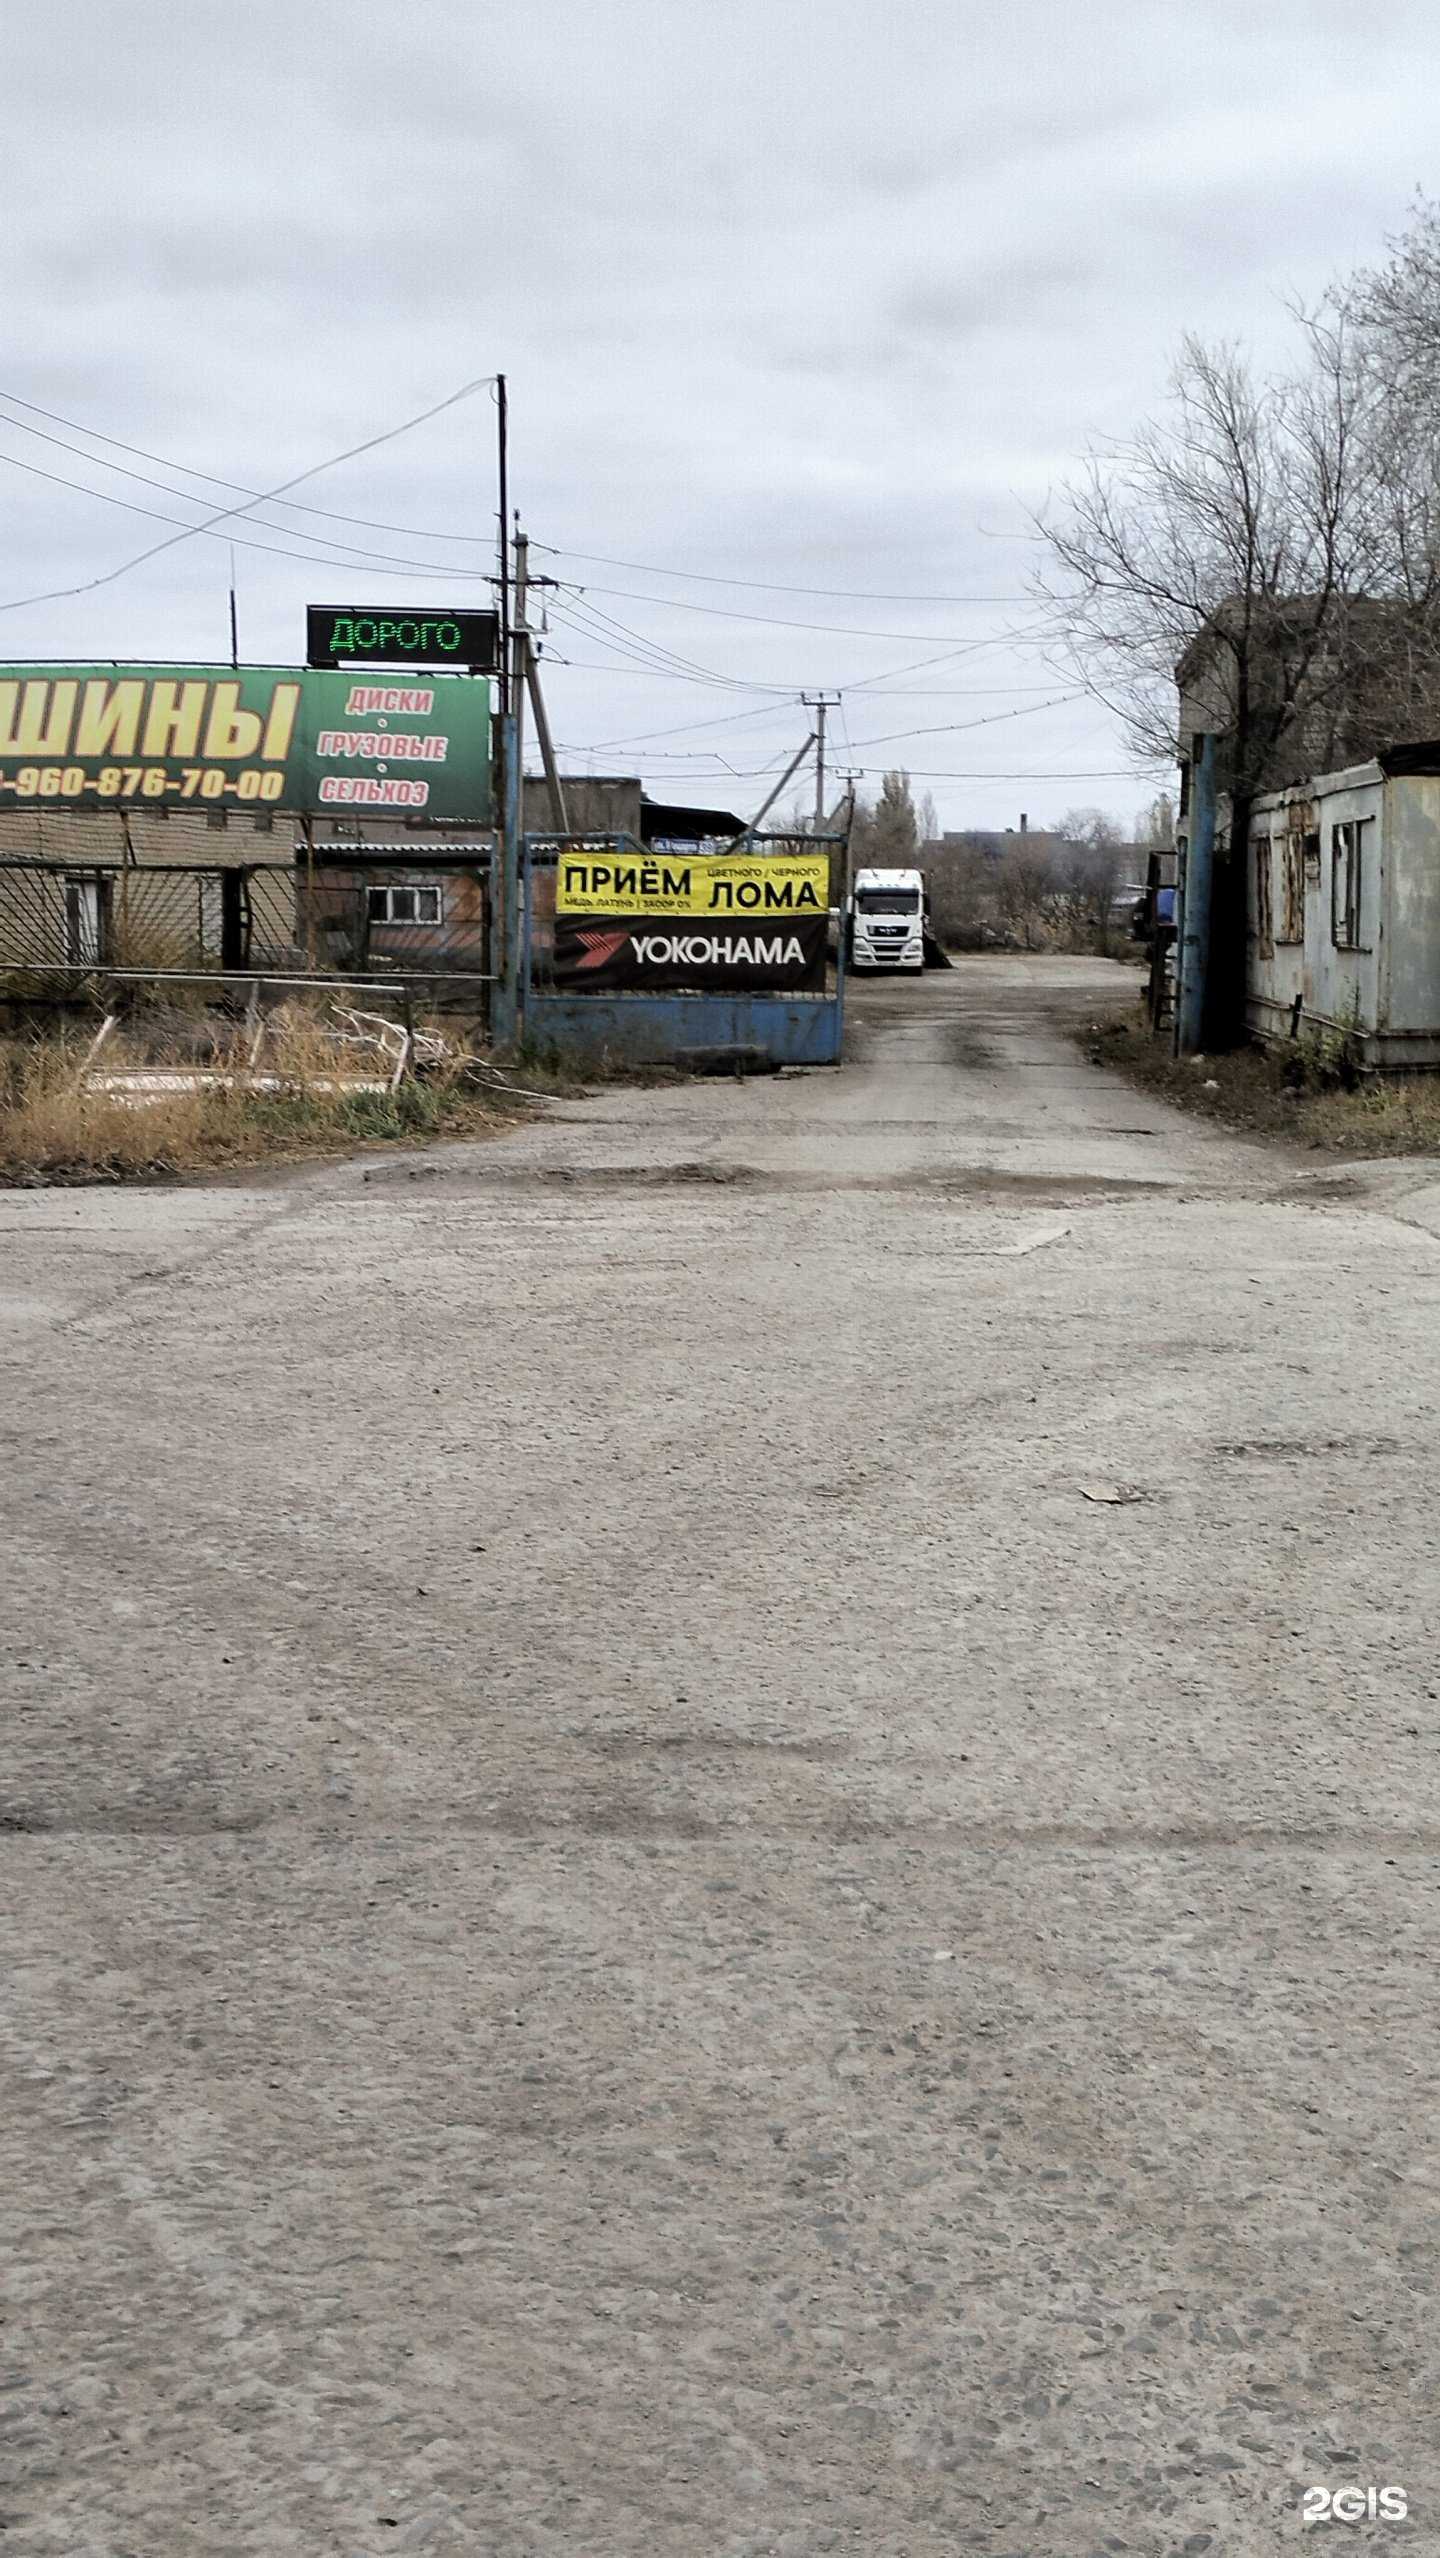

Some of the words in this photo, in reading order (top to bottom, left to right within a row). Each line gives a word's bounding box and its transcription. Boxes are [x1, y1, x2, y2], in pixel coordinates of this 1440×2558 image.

[330, 619, 461, 651] ДОРОГО
[346, 687, 434, 716] ДИСКИ
[0, 678, 301, 761] ШИНЫ
[317, 731, 448, 762] ГРУЗОВЫЕ
[0, 766, 285, 800] -960-876-70-00
[319, 777, 429, 806] СЕЛЬХОЗ
[565, 860, 691, 895] ПРИЁМ
[707, 867, 762, 878] ЦВЕТНОГО
[708, 881, 819, 908] ЛОМА
[630, 936, 806, 964] YOKOHAMA
